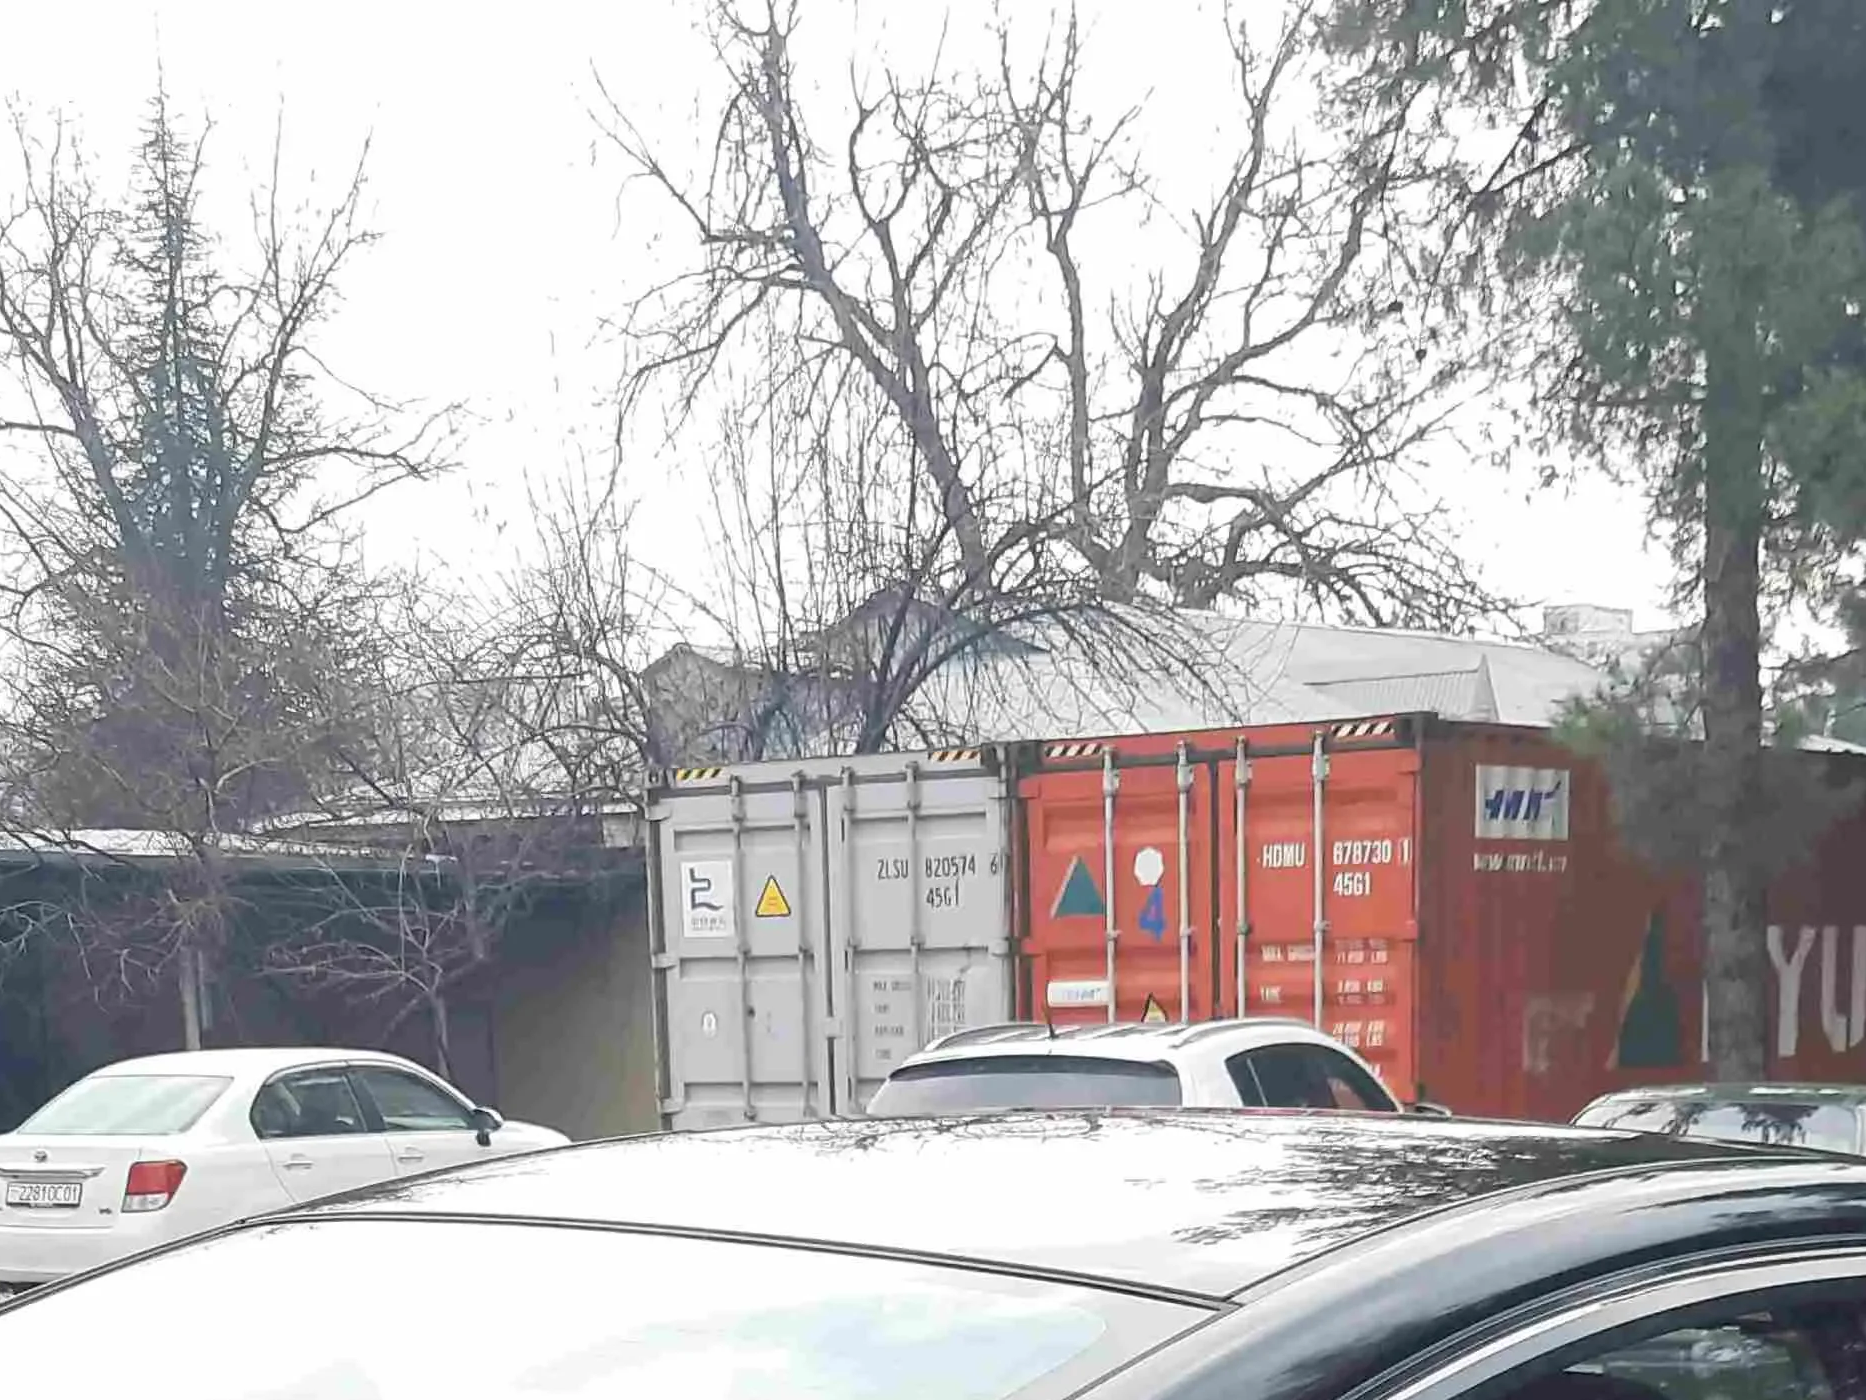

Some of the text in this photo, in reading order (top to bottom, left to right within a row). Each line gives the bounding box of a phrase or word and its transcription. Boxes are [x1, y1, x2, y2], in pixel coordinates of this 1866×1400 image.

[878, 858, 908, 880] ZLSU
[925, 854, 976, 878] 820574
[1262, 842, 1305, 868] HDMU
[1332, 872, 1371, 897] 45G1
